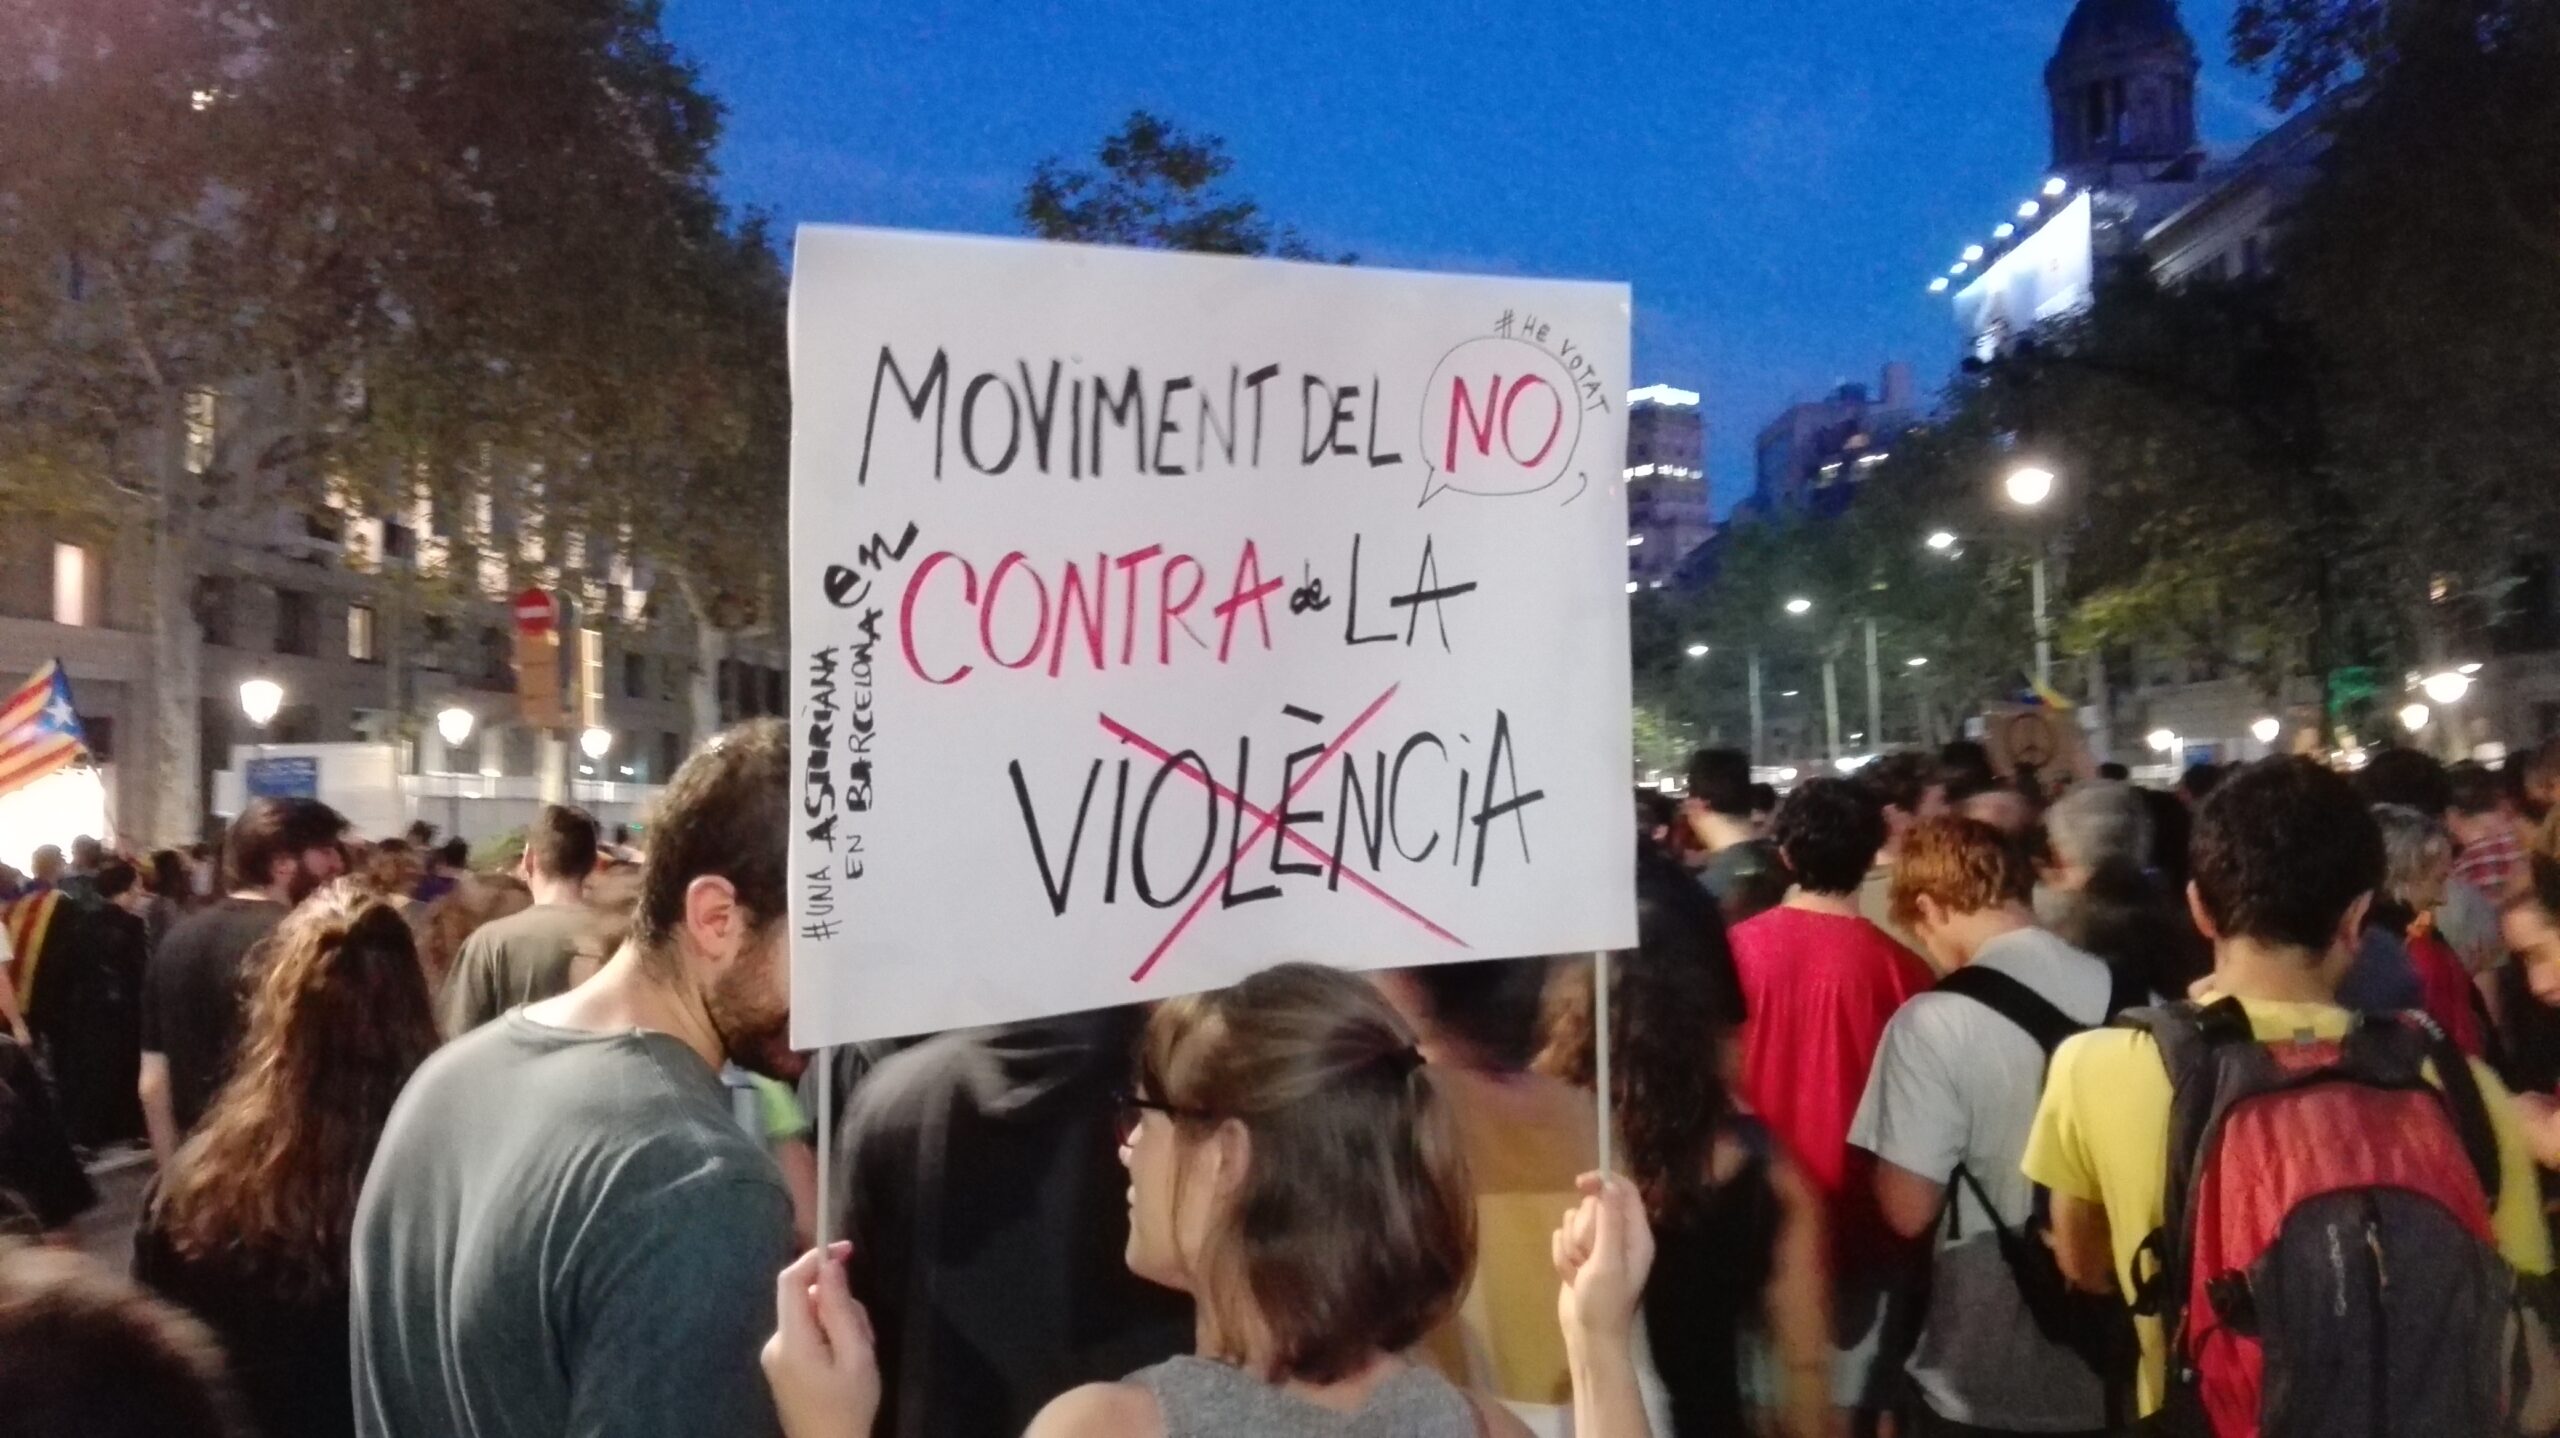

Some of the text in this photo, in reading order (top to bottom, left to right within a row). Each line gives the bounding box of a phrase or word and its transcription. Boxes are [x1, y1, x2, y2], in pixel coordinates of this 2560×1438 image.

[857, 345, 1562, 486] MOVIMENT DEL NO
[1558, 338, 1611, 415] VOTAT
[899, 538, 1285, 686] CONTRA
[1289, 558, 1332, 616] de
[1344, 532, 1478, 654] LA
[845, 607, 884, 881] EN BARCELONA
[800, 865, 844, 942] #UNA
